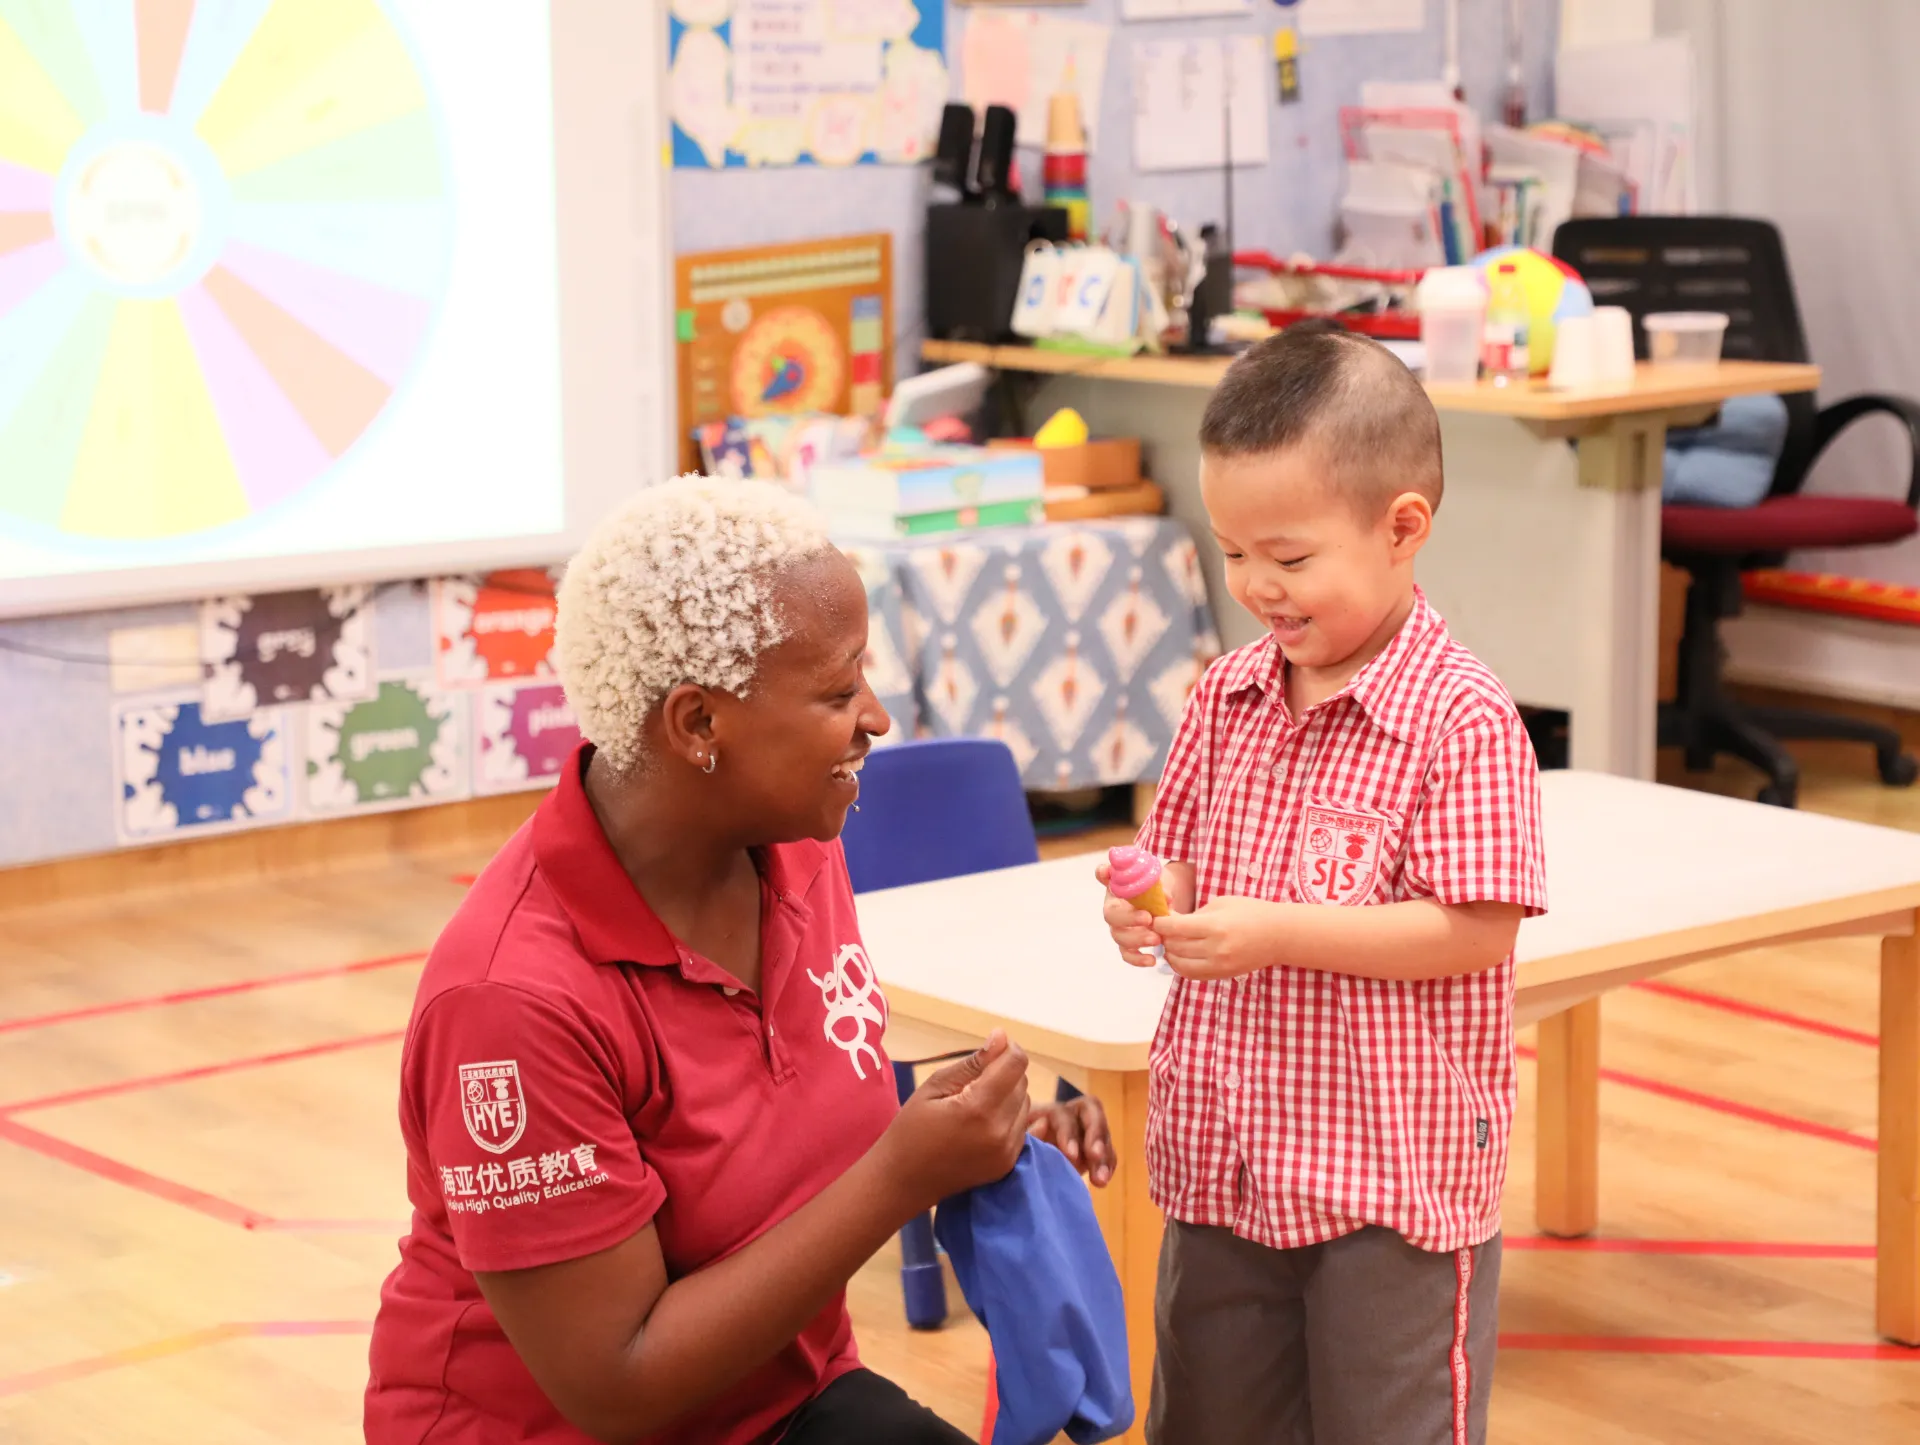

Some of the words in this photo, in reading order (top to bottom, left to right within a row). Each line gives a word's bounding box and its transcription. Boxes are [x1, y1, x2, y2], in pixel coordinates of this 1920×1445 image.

[473, 606, 555, 637] orange
[256, 626, 316, 664] grey
[179, 745, 236, 776] blue
[350, 727, 419, 762] green
[1311, 857, 1357, 901] SLS
[472, 1101, 515, 1138] HYE
[439, 1142, 598, 1197] 海亚优质教育
[465, 1197, 491, 1215] High
[493, 1190, 541, 1210] Quality
[543, 1172, 609, 1199] Education
